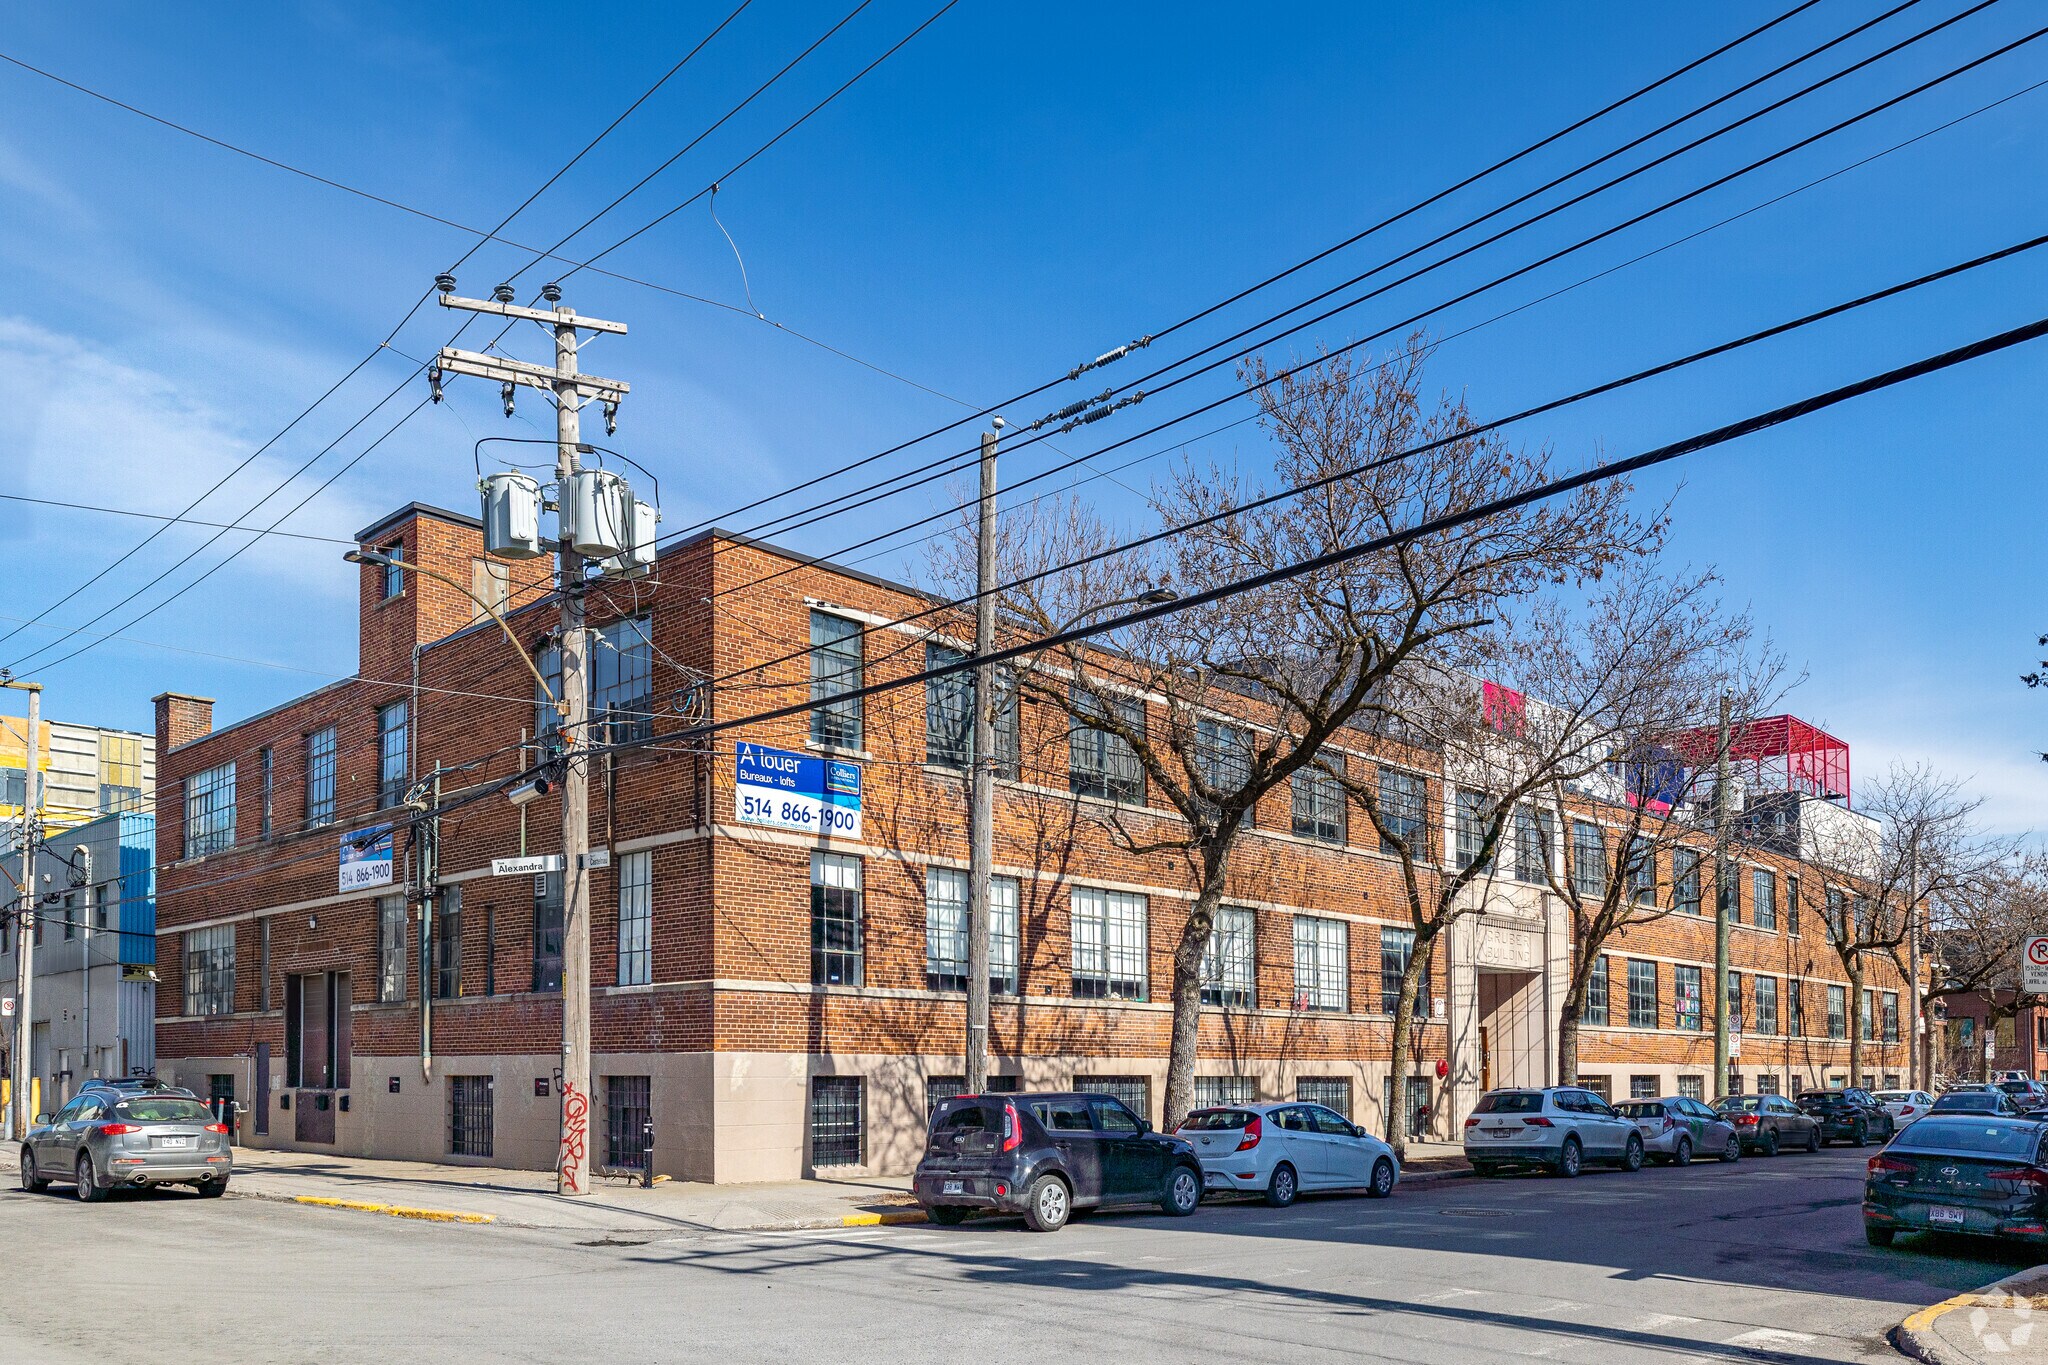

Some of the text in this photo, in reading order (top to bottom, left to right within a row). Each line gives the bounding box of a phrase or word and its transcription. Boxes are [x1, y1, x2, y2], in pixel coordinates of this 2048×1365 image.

[760, 748, 802, 774] louer
[740, 769, 773, 784] Bureaux
[779, 775, 796, 788] lofts
[830, 766, 856, 780] Colliers
[744, 796, 854, 831] 514 866-1900
[341, 862, 390, 886] 514 866-1900
[498, 862, 543, 874] Alexandra
[1487, 930, 1530, 947] GRUBER
[1487, 946, 1531, 962] BUILDING
